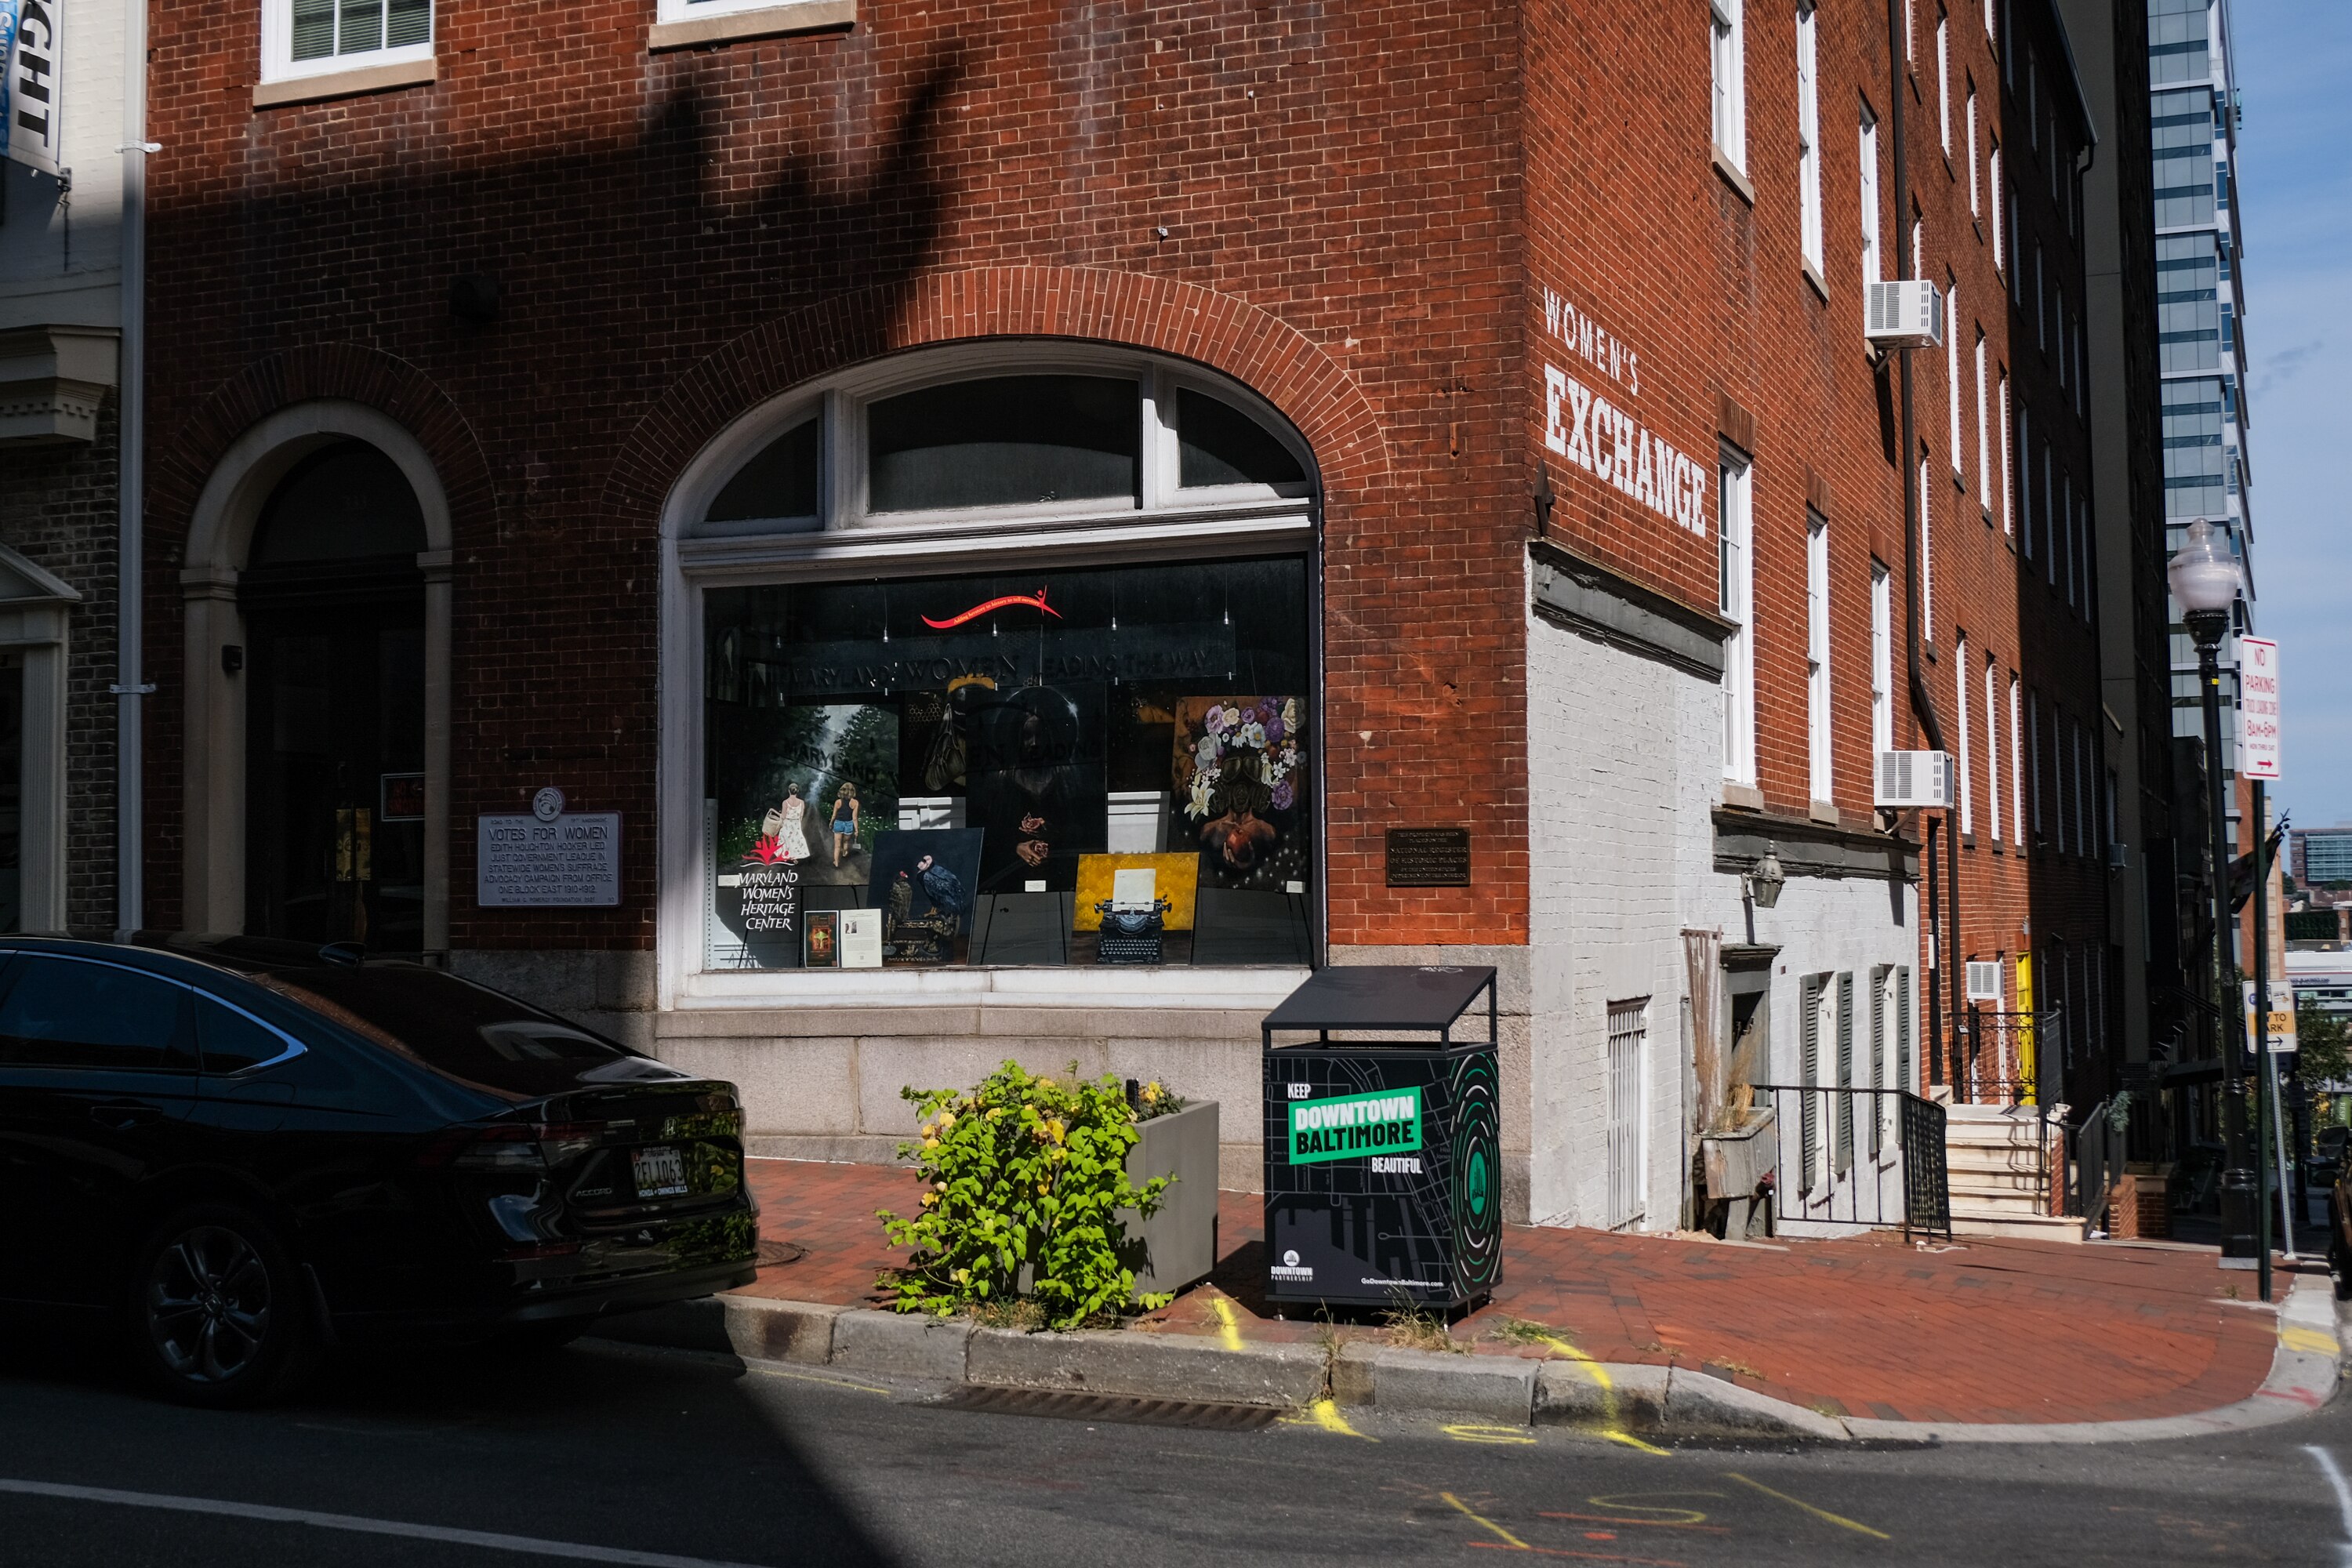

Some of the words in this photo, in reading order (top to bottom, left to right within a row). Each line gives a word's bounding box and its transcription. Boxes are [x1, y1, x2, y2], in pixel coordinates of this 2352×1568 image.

[1544, 286, 1638, 396] WOMEN'S
[1544, 363, 1706, 538] EXCHANGE
[953, 615, 968, 625] Adding
[991, 599, 1007, 608] history
[2254, 648, 2266, 666] NO
[2245, 674, 2275, 694] PARKING
[2247, 720, 2277, 739] 8AM-6PM
[488, 828, 526, 841] VOTES
[533, 827, 557, 841] FOR
[564, 826, 608, 840] WOMEN
[491, 844, 513, 852] EDITH
[515, 843, 554, 851] HOUGHTON
[557, 842, 587, 851] HOOKER
[514, 853, 564, 862] GOVERNMENT
[566, 852, 597, 861] LEAGUE
[488, 864, 532, 873] STATEWIDE
[568, 863, 608, 872] SUFFRAGE
[485, 875, 522, 884] ADVOCACY
[524, 874, 561, 883] CAMPAIGN
[586, 873, 613, 882] OFFICE
[735, 869, 798, 888] MARYLAND
[499, 885, 514, 894] ONE
[515, 885, 539, 894] BLOCK
[742, 884, 794, 902] WOMEN'S
[740, 900, 796, 916] HERITAGE
[746, 916, 793, 931] CENTER
[2274, 1013, 2287, 1022] TO
[1287, 1083, 1312, 1099] KEEP
[1295, 1095, 1415, 1131] DOWNTOWN
[1296, 1121, 1414, 1156] BALTIMORE
[1371, 1156, 1424, 1174] BEAUTIFUL
[1271, 1265, 1313, 1276] DOWNTOWN
[1361, 1277, 1444, 1287] GoDowntownBaltimore.com
